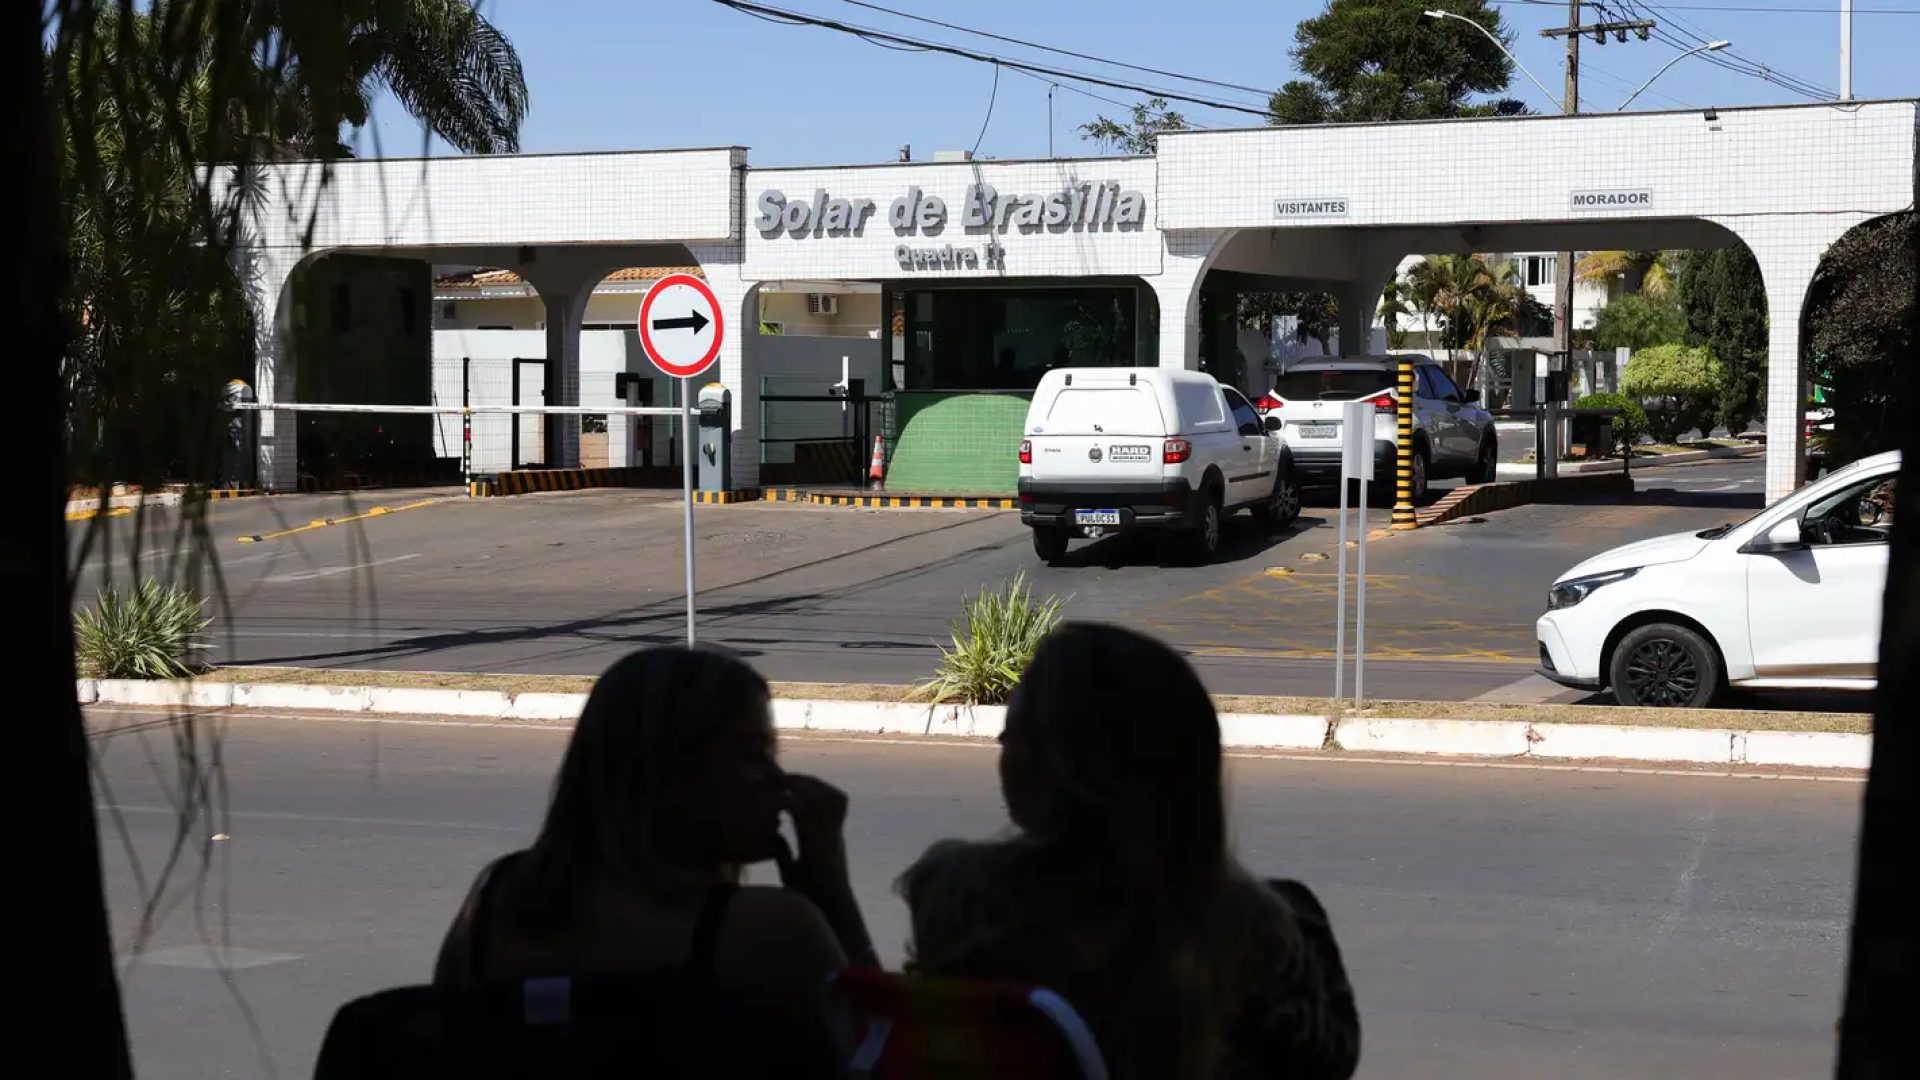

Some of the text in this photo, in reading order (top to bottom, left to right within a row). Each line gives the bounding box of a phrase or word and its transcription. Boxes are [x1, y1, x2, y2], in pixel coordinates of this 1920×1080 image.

[755, 179, 1143, 233] Solar de Brasília
[1573, 193, 1648, 205] MORADOR
[1277, 202, 1346, 214] VISITANTES
[894, 243, 977, 265] Quadra
